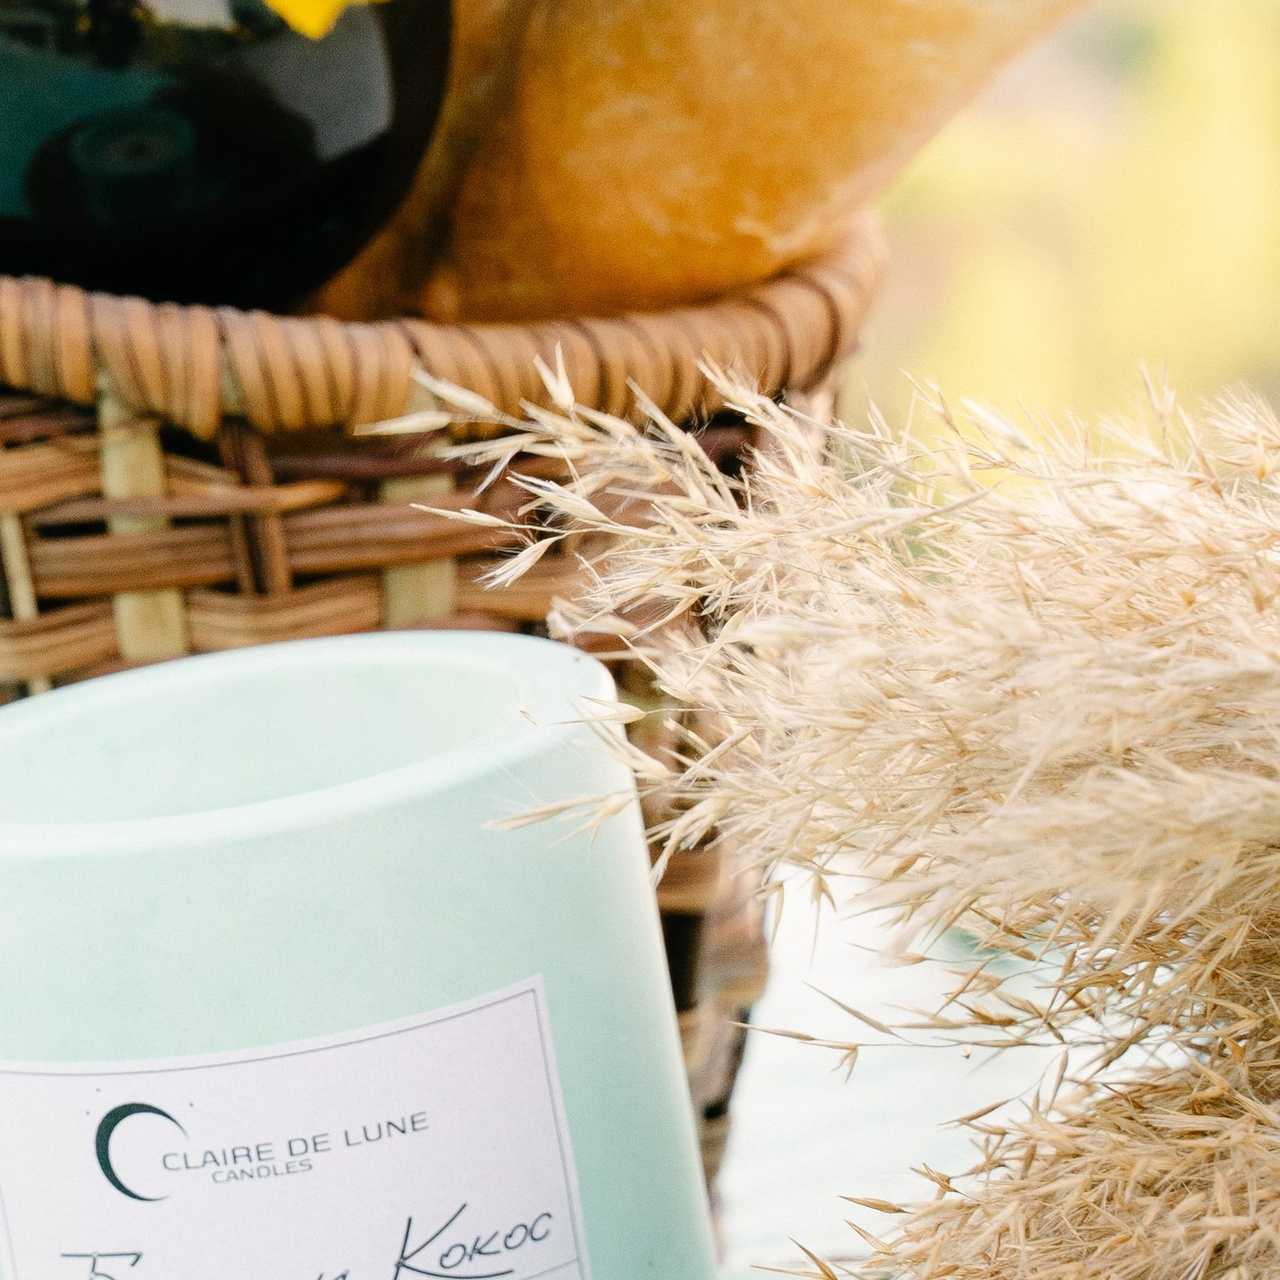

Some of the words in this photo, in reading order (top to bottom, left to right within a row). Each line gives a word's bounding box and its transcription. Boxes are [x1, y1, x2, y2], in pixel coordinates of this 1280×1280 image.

[161, 1141, 276, 1172] CLAIRE
[287, 1132, 332, 1158] DE
[343, 1110, 431, 1147] LUNE
[210, 1157, 314, 1184] CANDLES
